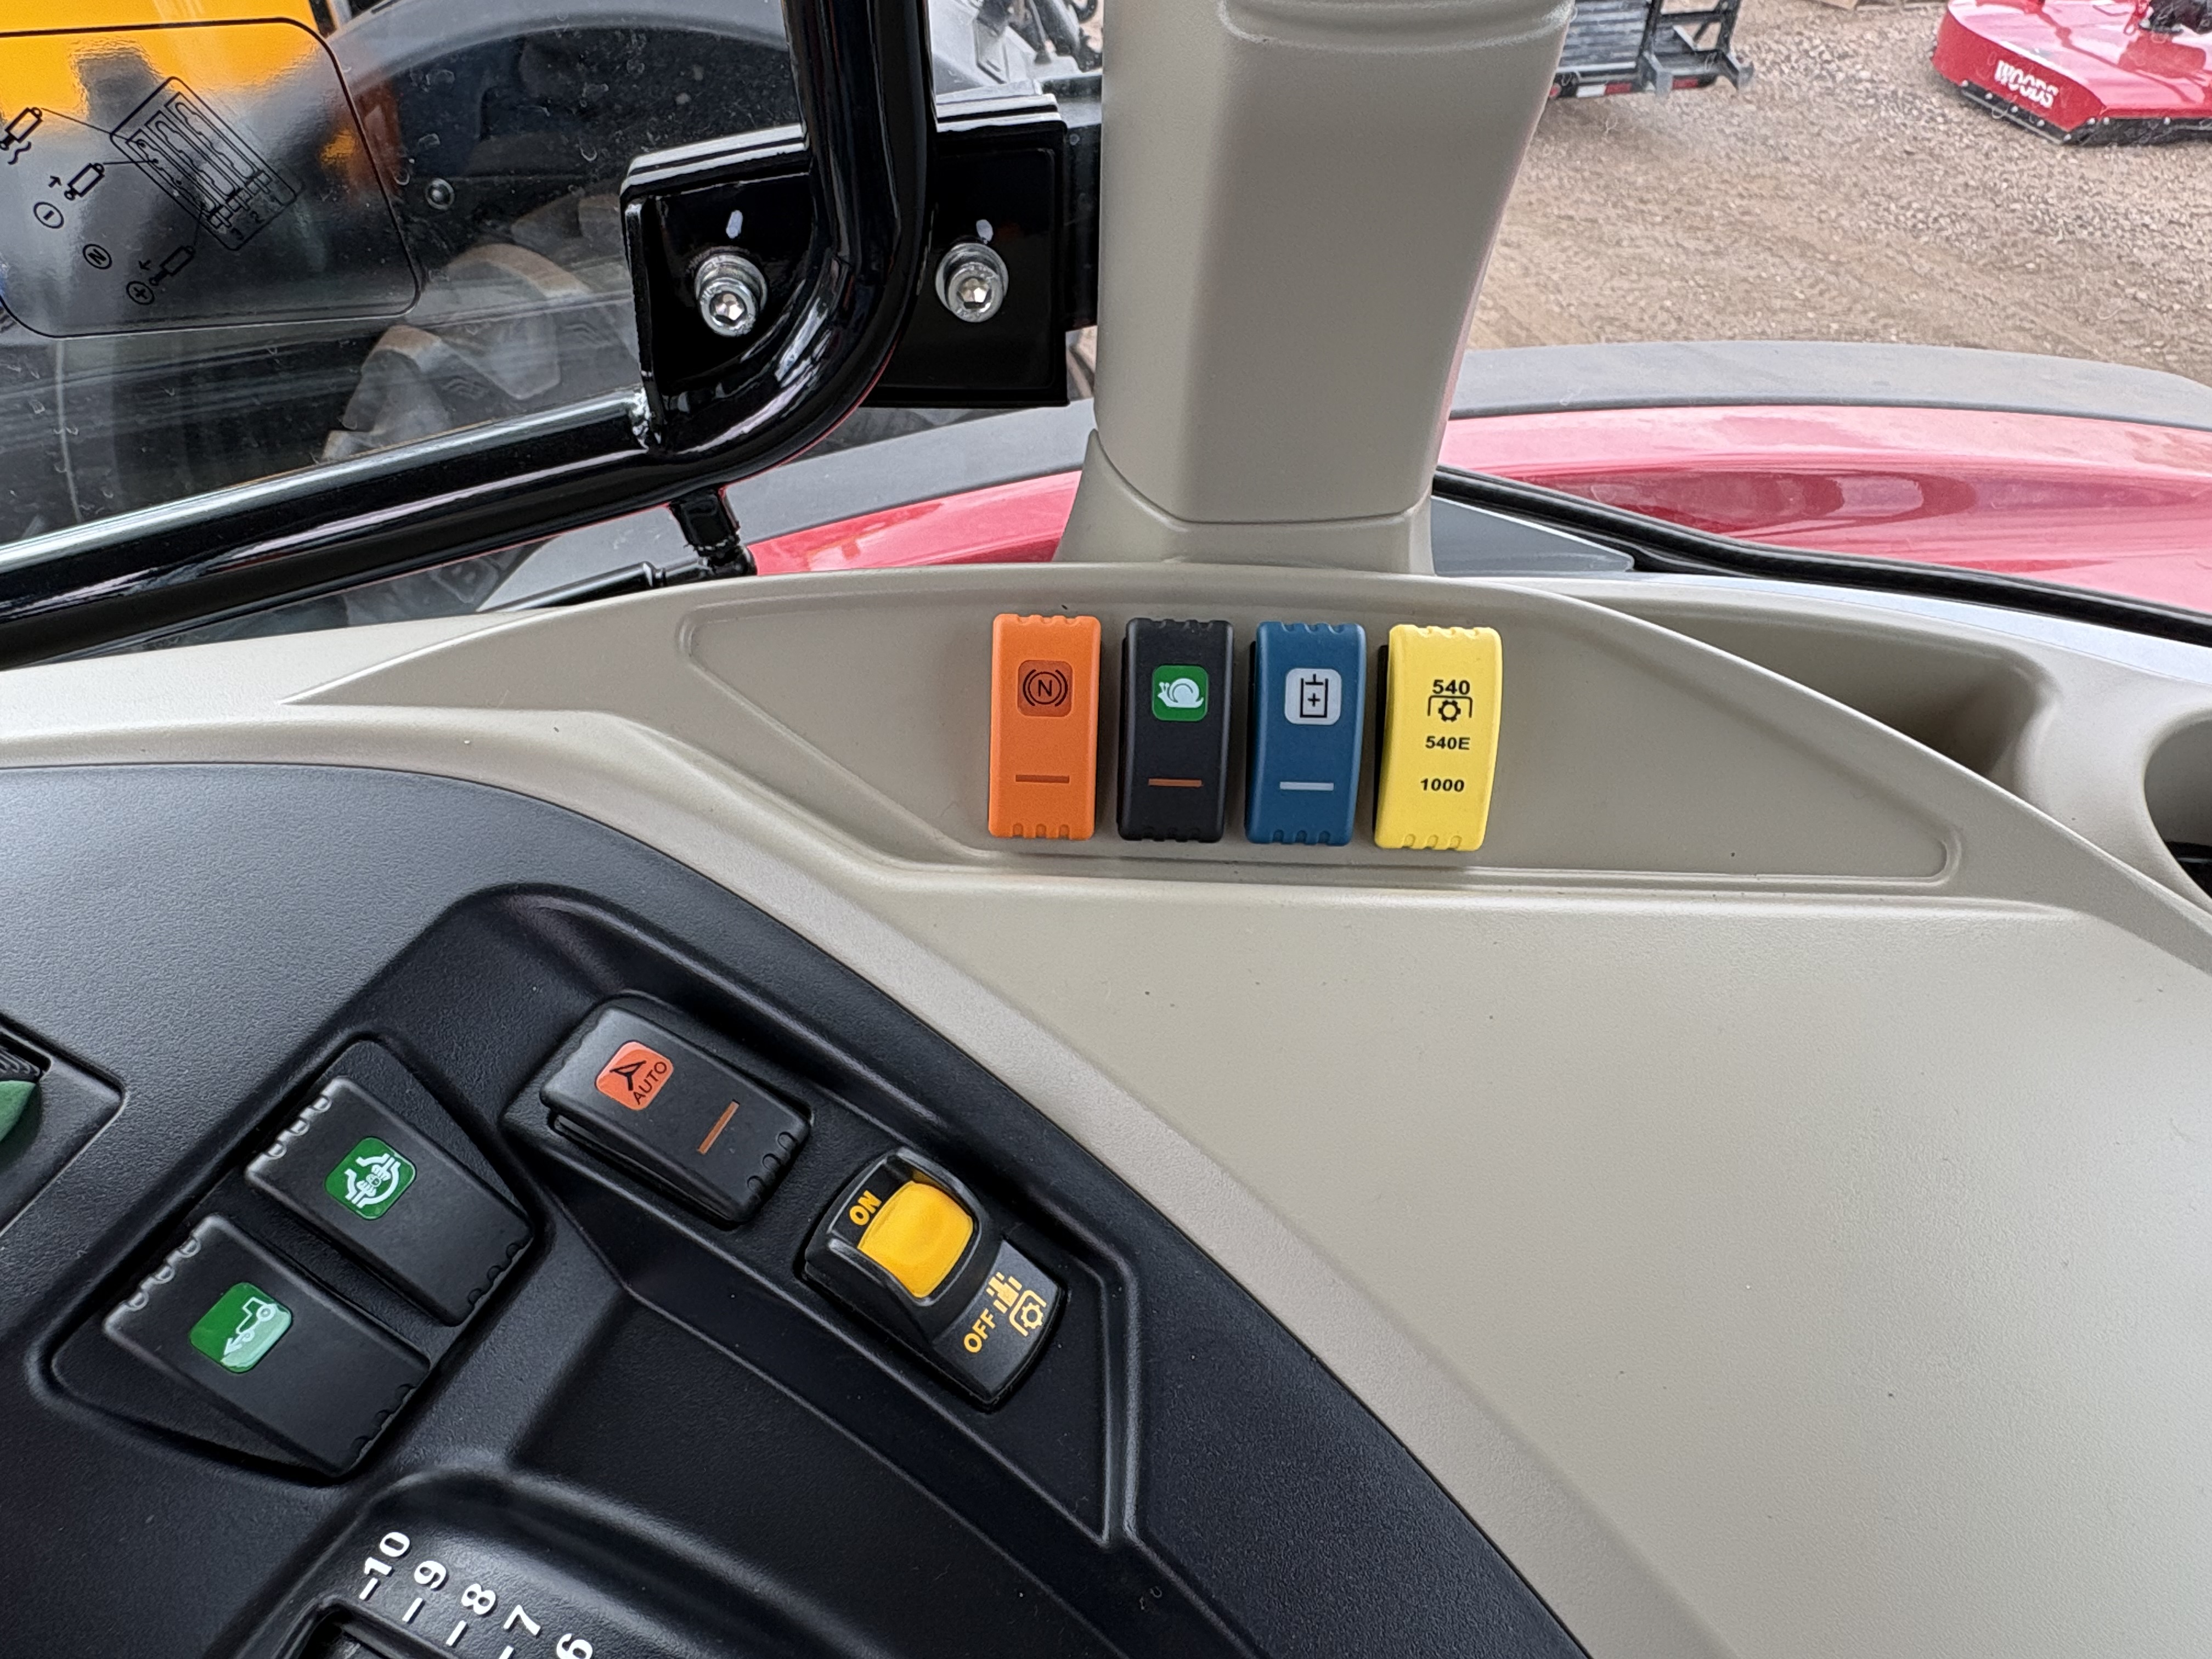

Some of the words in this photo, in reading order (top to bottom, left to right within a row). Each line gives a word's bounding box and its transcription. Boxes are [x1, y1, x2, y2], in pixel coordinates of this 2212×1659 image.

[1995, 60, 2059, 108] WOODS
[1038, 680, 1052, 697] N
[1432, 679, 1470, 695] 540
[1426, 736, 1470, 750] 540E
[1420, 777, 1465, 792] 1000
[633, 1062, 667, 1105] AUTO
[849, 1190, 882, 1226] ON
[963, 1309, 996, 1353] OFF
[364, 1532, 410, 1576] 10
[414, 1561, 447, 1589] 9
[461, 1584, 496, 1615] 8
[504, 1605, 541, 1636] 7
[556, 1634, 593, 1659] 6
